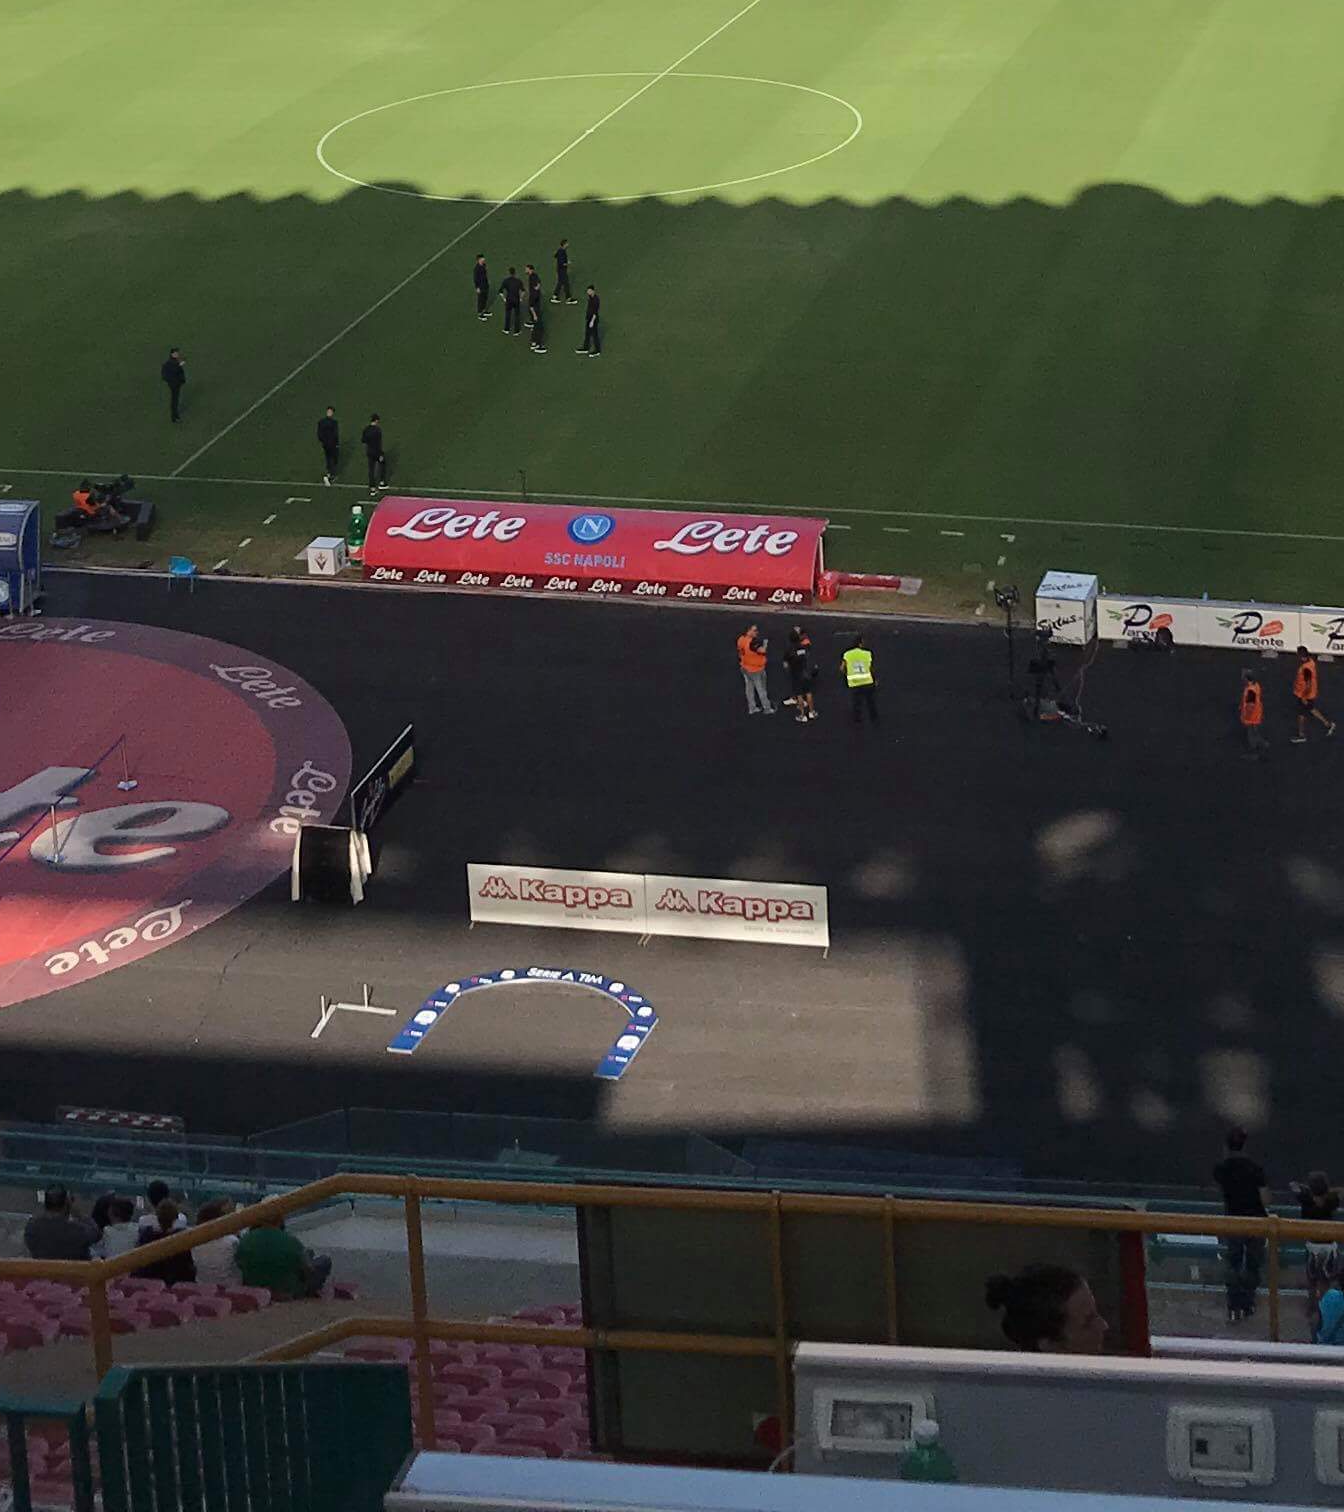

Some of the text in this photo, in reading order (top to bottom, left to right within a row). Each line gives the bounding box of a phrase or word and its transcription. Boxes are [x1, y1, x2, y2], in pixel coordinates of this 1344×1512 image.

[387, 507, 529, 542] Lete
[653, 519, 801, 557] Lete
[575, 554, 627, 569] NAPOLI
[371, 567, 803, 605] Lete Lete Lete Lete Lete Lete Lete Lete Lete Lete
[1233, 611, 1284, 648] Parente
[208, 663, 303, 710] Lete
[269, 760, 337, 836] Lete
[520, 878, 633, 908] Kappa
[698, 889, 814, 922] Kappa
[43, 898, 195, 979] Lete
[578, 972, 604, 985] TIM
